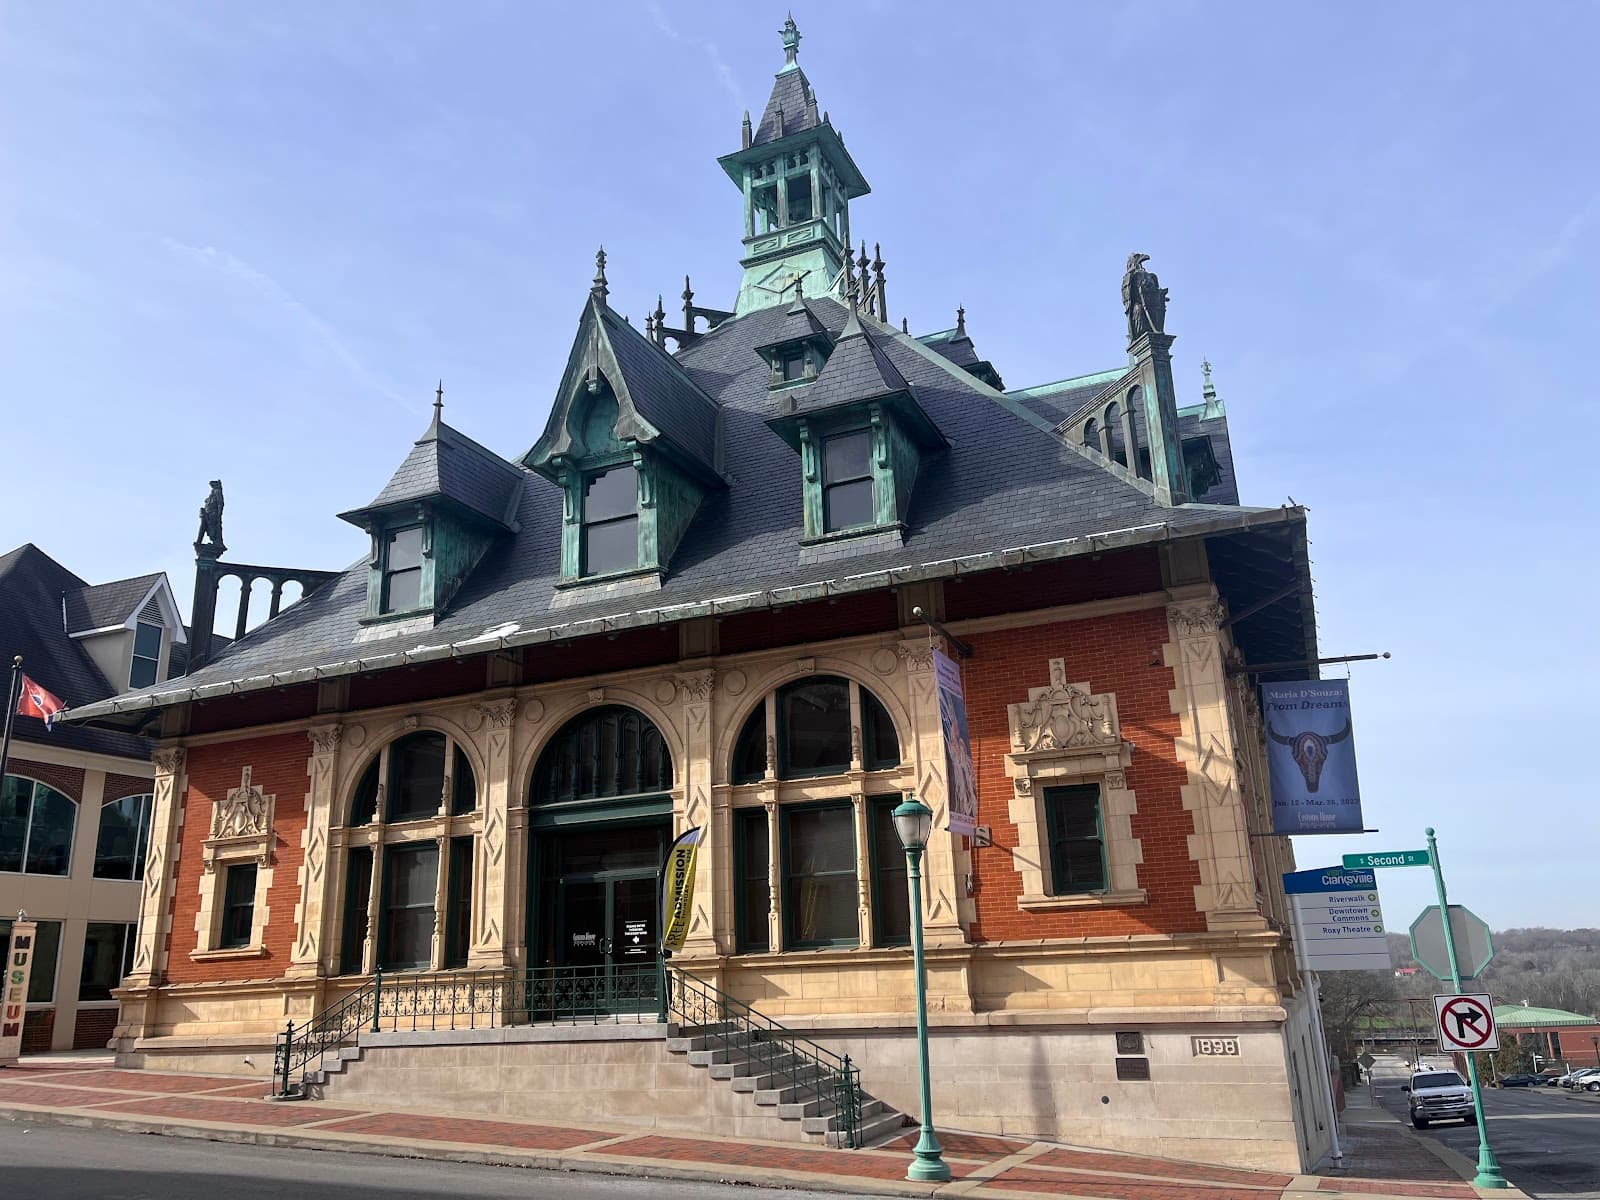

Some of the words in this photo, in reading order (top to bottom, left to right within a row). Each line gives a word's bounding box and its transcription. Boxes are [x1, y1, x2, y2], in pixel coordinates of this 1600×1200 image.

[1270, 691, 1298, 699] Maria
[1367, 854, 1405, 866] Second
[674, 849, 686, 919] ADMISSION
[1321, 874, 1374, 886] Clarksville
[1328, 895, 1365, 903] Riverwalk
[665, 921, 685, 946] FREE
[2, 935, 31, 1037] MUSEUM
[1196, 1039, 1235, 1054] 1898
